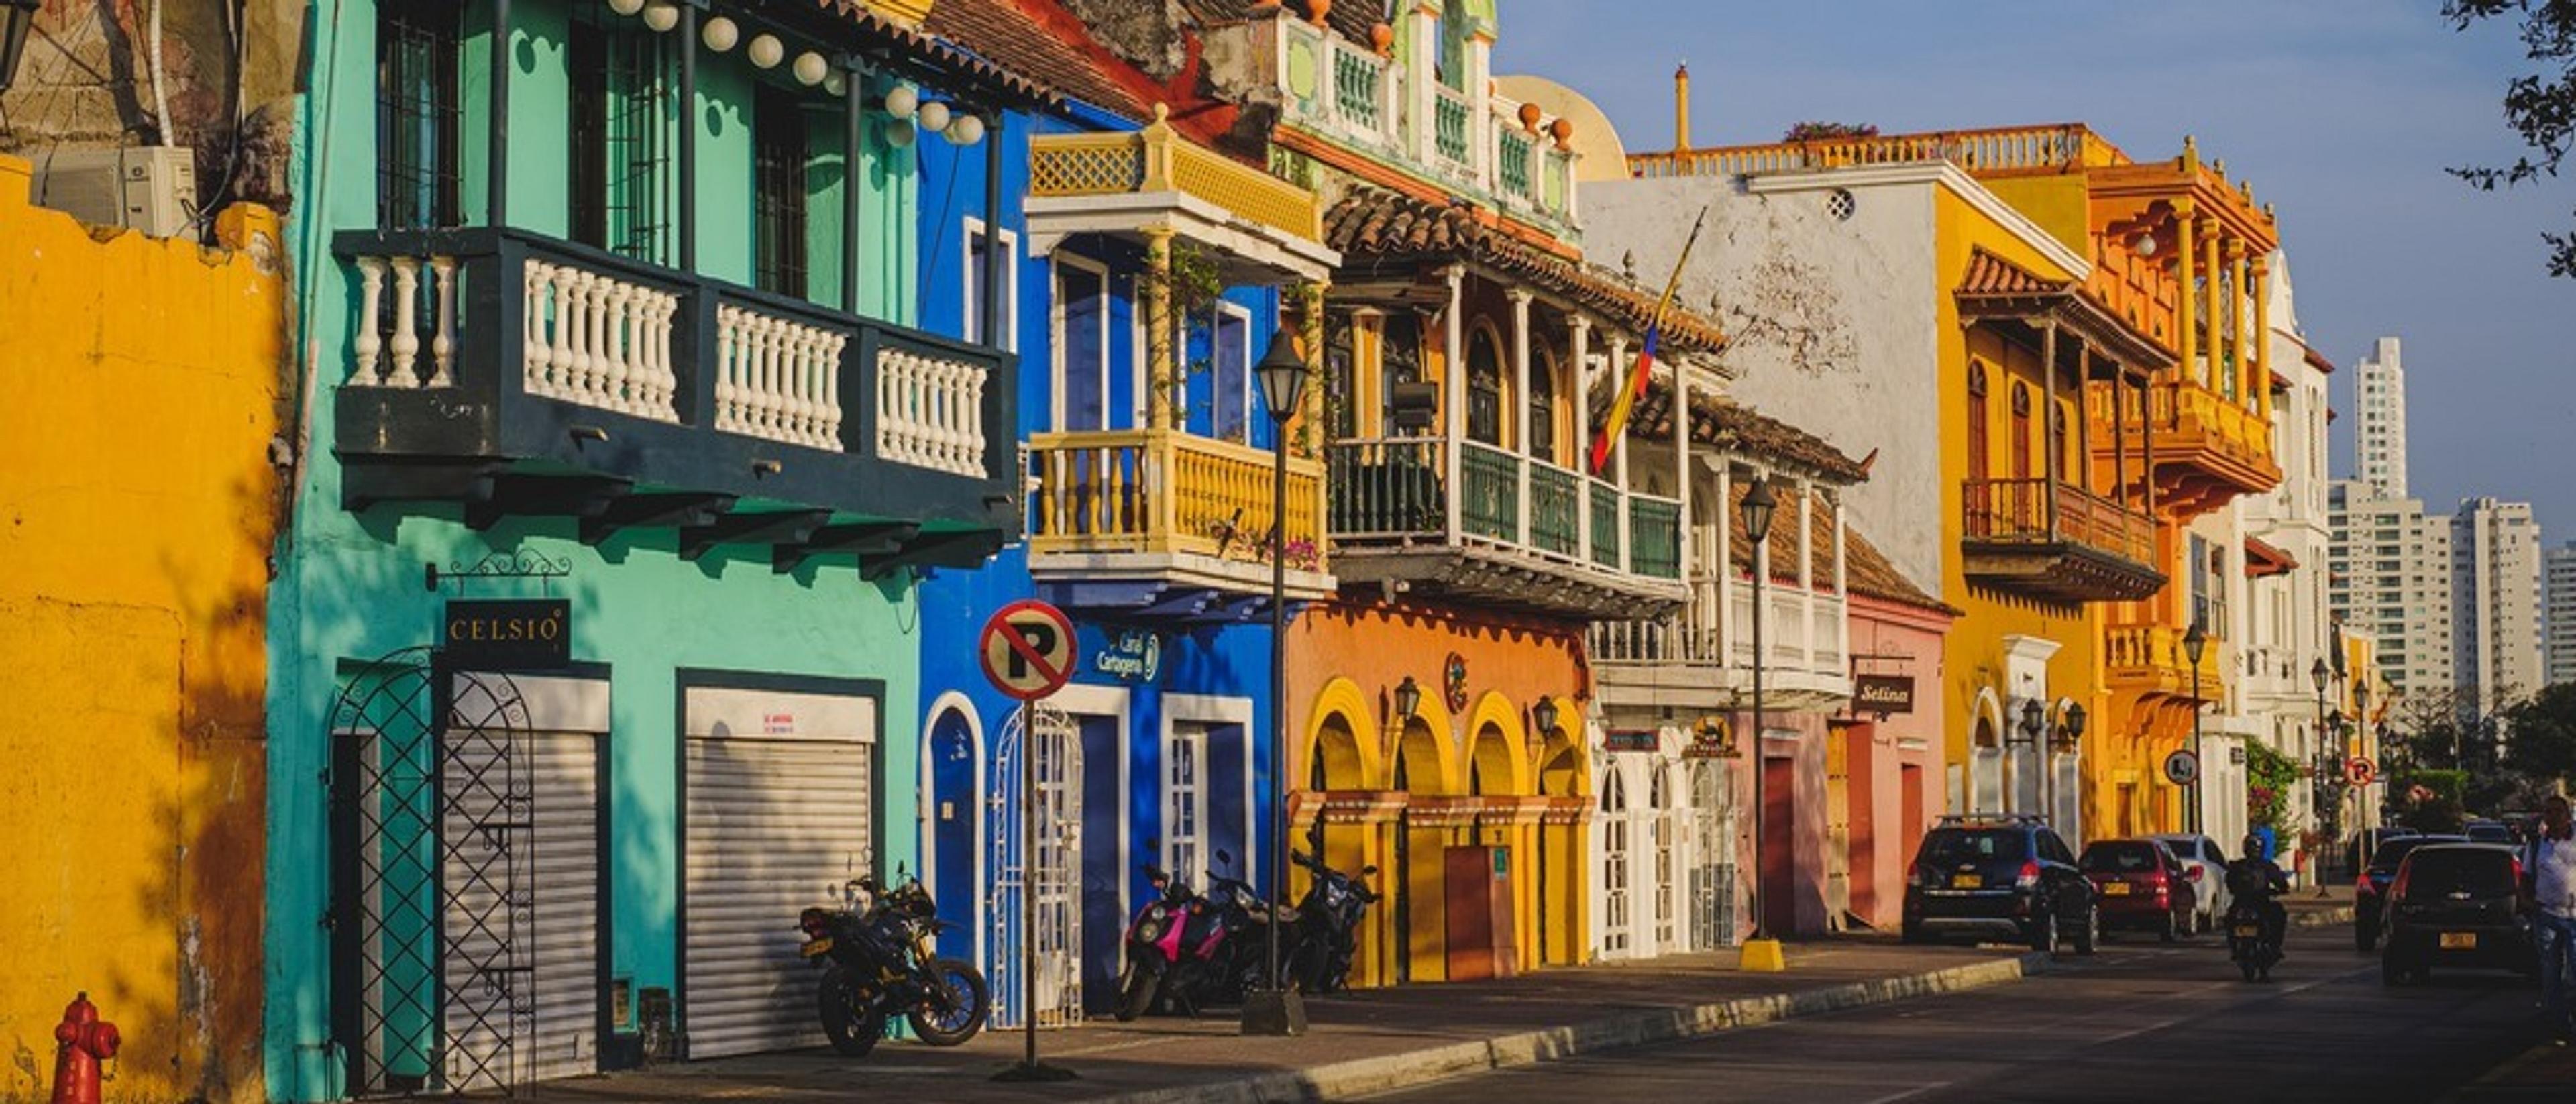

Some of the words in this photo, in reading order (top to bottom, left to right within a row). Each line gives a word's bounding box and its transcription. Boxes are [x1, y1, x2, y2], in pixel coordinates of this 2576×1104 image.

[1008, 622, 1056, 679] P
[1097, 651, 1143, 678] Cartagena
[1861, 684, 1908, 702] Selina
